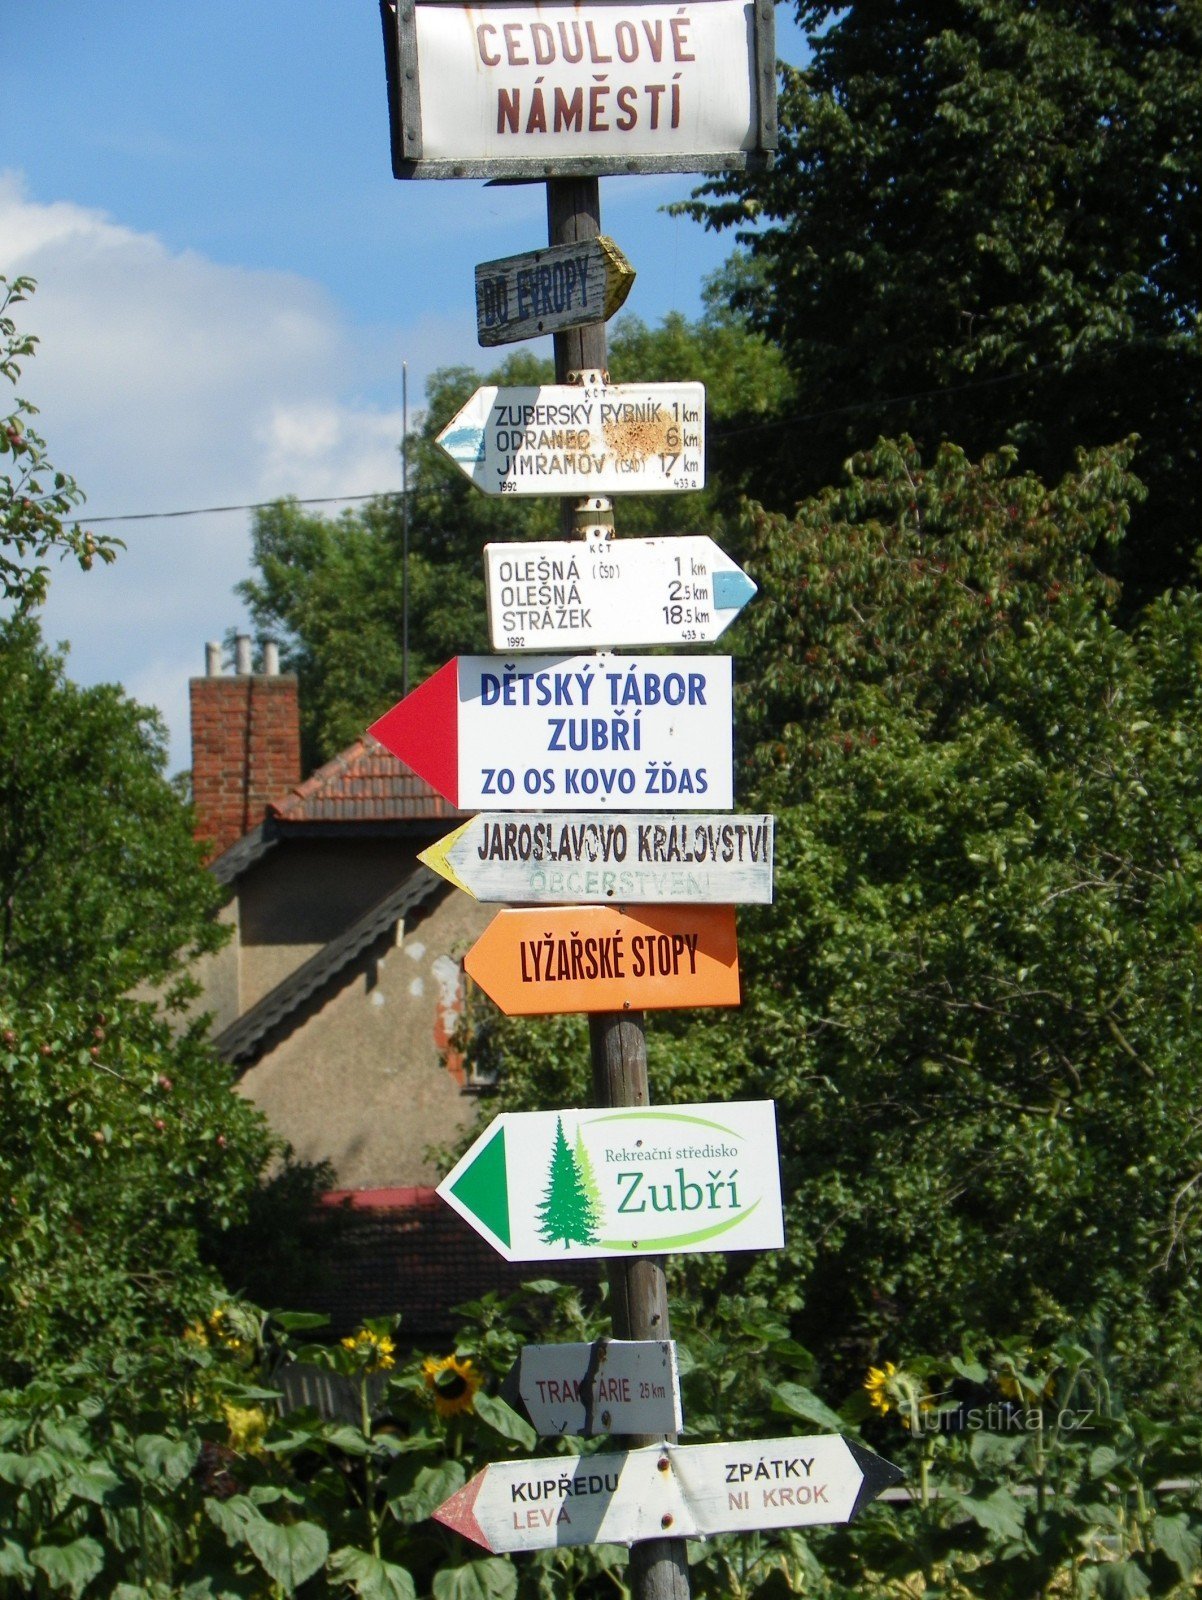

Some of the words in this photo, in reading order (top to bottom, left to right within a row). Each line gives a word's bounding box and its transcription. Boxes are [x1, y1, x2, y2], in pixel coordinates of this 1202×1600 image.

[476, 8, 695, 66] CEDULOVÉ
[497, 73, 682, 134] NÁMĚSTÍ
[517, 253, 590, 321] EVROPY
[495, 399, 593, 427] ZUBERSKÝ
[600, 397, 662, 424] RYBNÍK
[672, 403, 679, 422] 1
[683, 403, 699, 422] km
[496, 429, 591, 452] ODRANEC
[665, 427, 679, 447] 6
[683, 428, 699, 447] km
[496, 452, 606, 476] JIMRAMOV
[658, 452, 680, 473] 17
[683, 454, 699, 472] km
[499, 481, 517, 492] 1992
[674, 478, 689, 488] 433
[691, 480, 697, 488] a
[500, 555, 580, 583] OLEŠNÁ
[674, 556, 681, 576] 1
[690, 557, 707, 576] km
[501, 581, 582, 607] OLEŠNÁ
[693, 583, 708, 600] km
[502, 605, 592, 631] STRÁŽEK
[695, 606, 710, 623] km
[507, 636, 525, 647] 1992
[682, 630, 696, 640] 433
[481, 664, 595, 706] DĚTSKÝ
[606, 664, 707, 706] TÁBOR
[547, 709, 642, 751] ZUBŘÍ
[481, 768, 515, 795] ZO
[523, 768, 555, 795] OS
[565, 768, 636, 795] KOVO
[645, 761, 709, 795] ŽĎAS
[478, 822, 627, 862] JAROSLAVOVO
[638, 816, 768, 863] KRÁLOVSTVÍ
[520, 930, 625, 982] LYŽAŘSKÉ
[632, 933, 698, 977] STOPY
[605, 1147, 672, 1162] Rekreační
[676, 1143, 738, 1160] středisko
[617, 1168, 741, 1213] Zubří
[535, 1373, 632, 1404] TRAÁRIE
[640, 1382, 650, 1399] 25
[651, 1383, 666, 1399] km
[725, 1457, 815, 1483] ZPÁTKY
[511, 1473, 619, 1502] KUPŘEDU
[728, 1491, 749, 1510] NI
[763, 1484, 829, 1507] KROK
